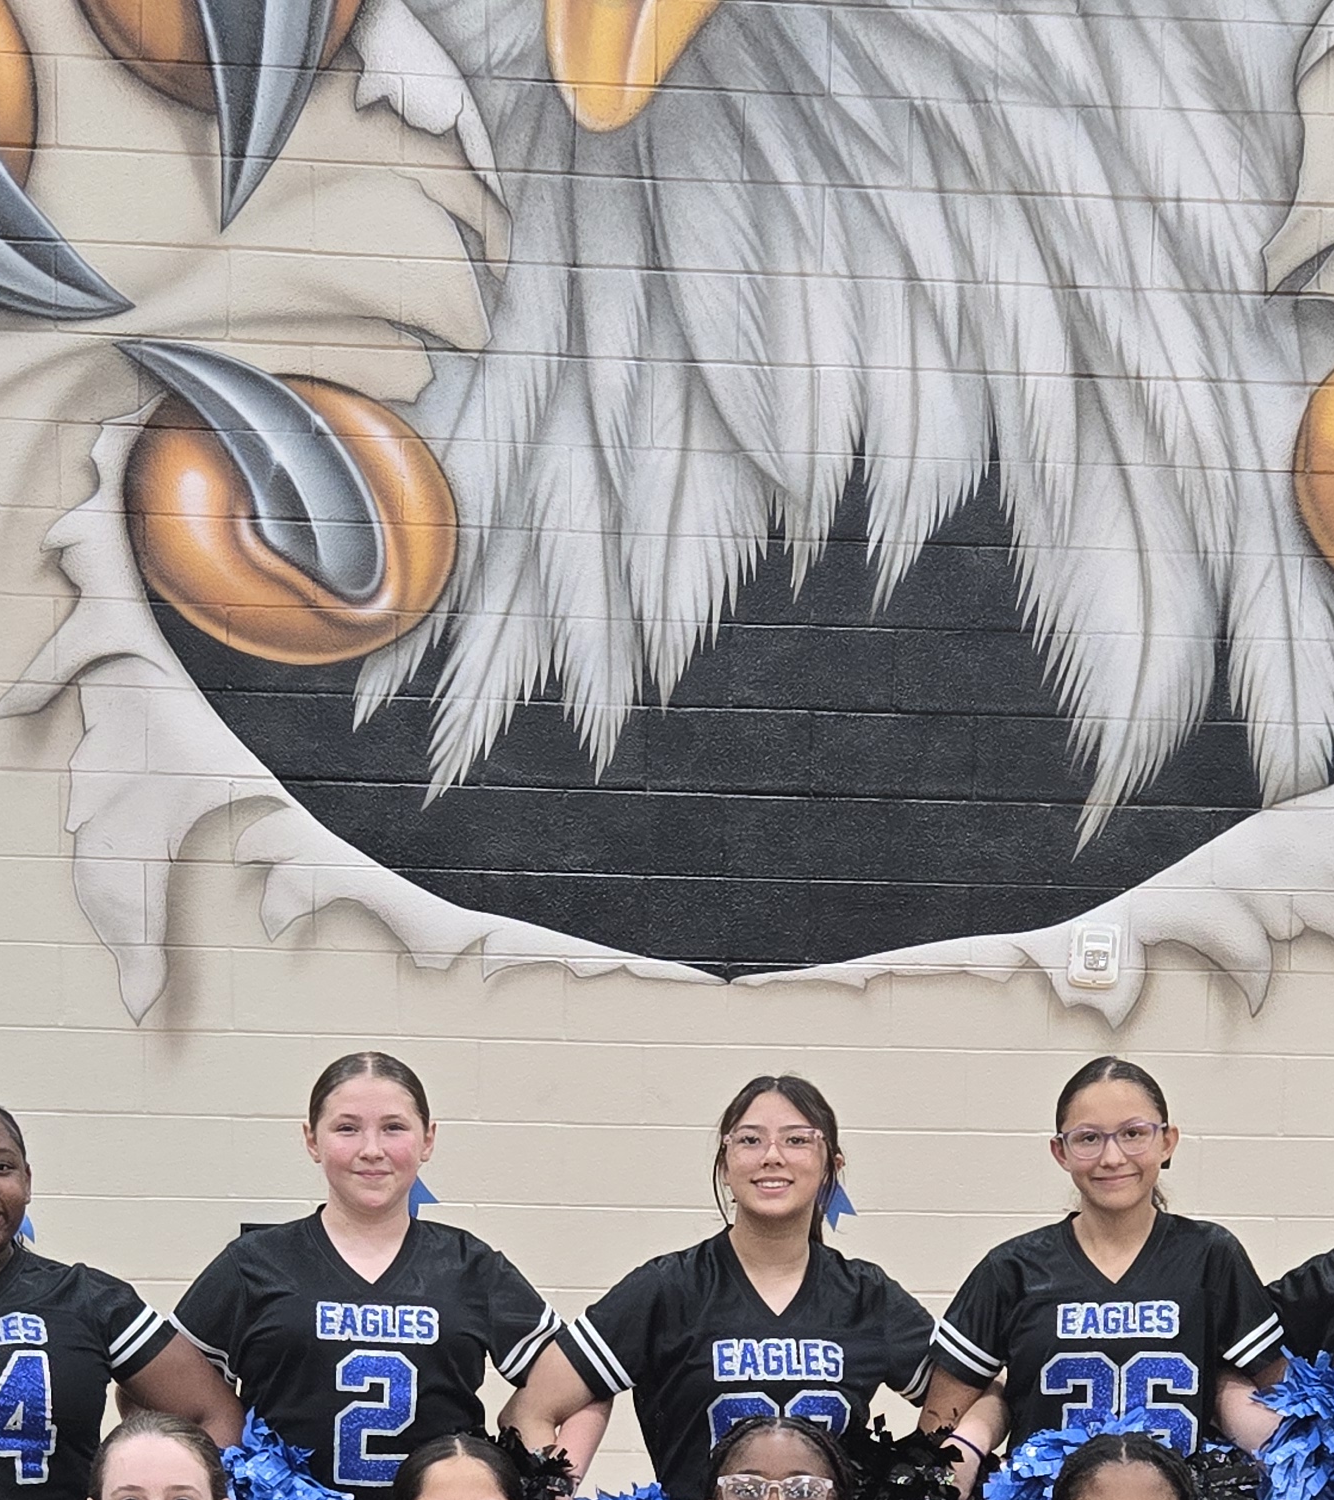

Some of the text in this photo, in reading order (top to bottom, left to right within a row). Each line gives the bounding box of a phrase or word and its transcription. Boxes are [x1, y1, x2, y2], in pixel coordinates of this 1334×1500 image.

[316, 1302, 439, 1344] EAGLES
[1057, 1300, 1180, 1339] EAGLES
[713, 1338, 844, 1382] EAGLES
[333, 1350, 418, 1488] 2
